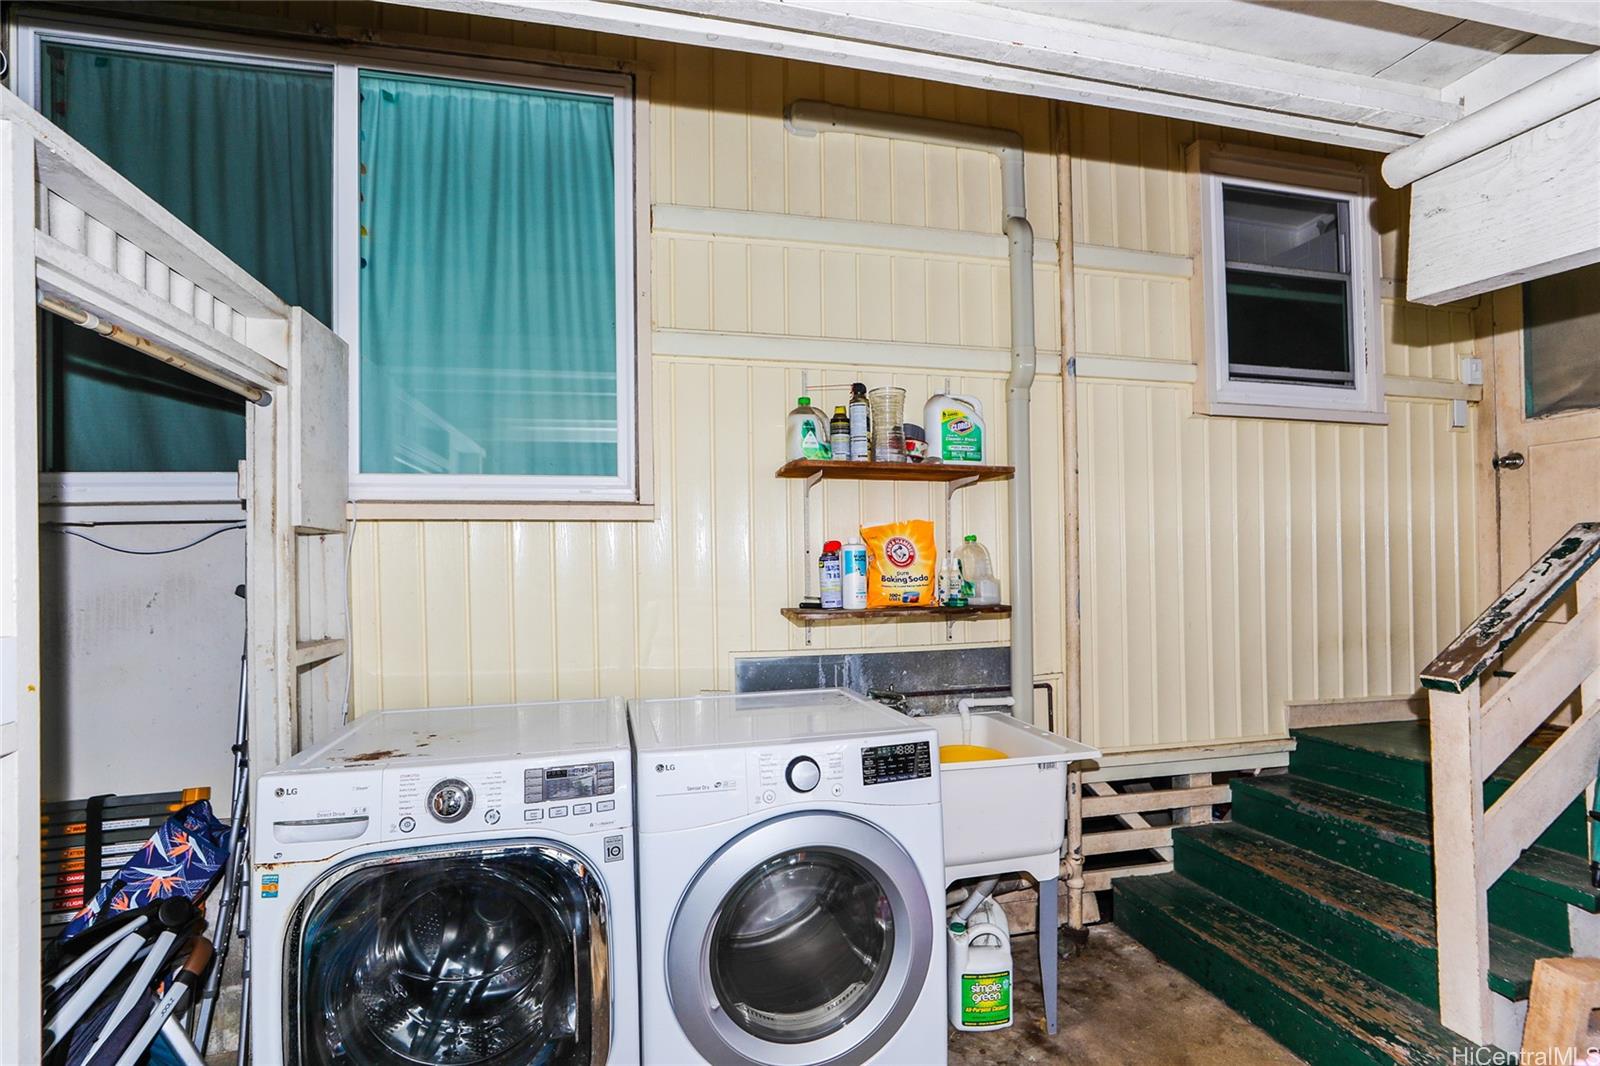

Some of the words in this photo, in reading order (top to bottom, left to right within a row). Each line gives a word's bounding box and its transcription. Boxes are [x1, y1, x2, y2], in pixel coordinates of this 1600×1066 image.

[881, 575, 908, 584] Baking
[908, 574, 929, 583] Soda
[665, 764, 676, 772] LG
[286, 787, 298, 796] LG
[971, 982, 1002, 994] simple
[972, 992, 1002, 1004] green
